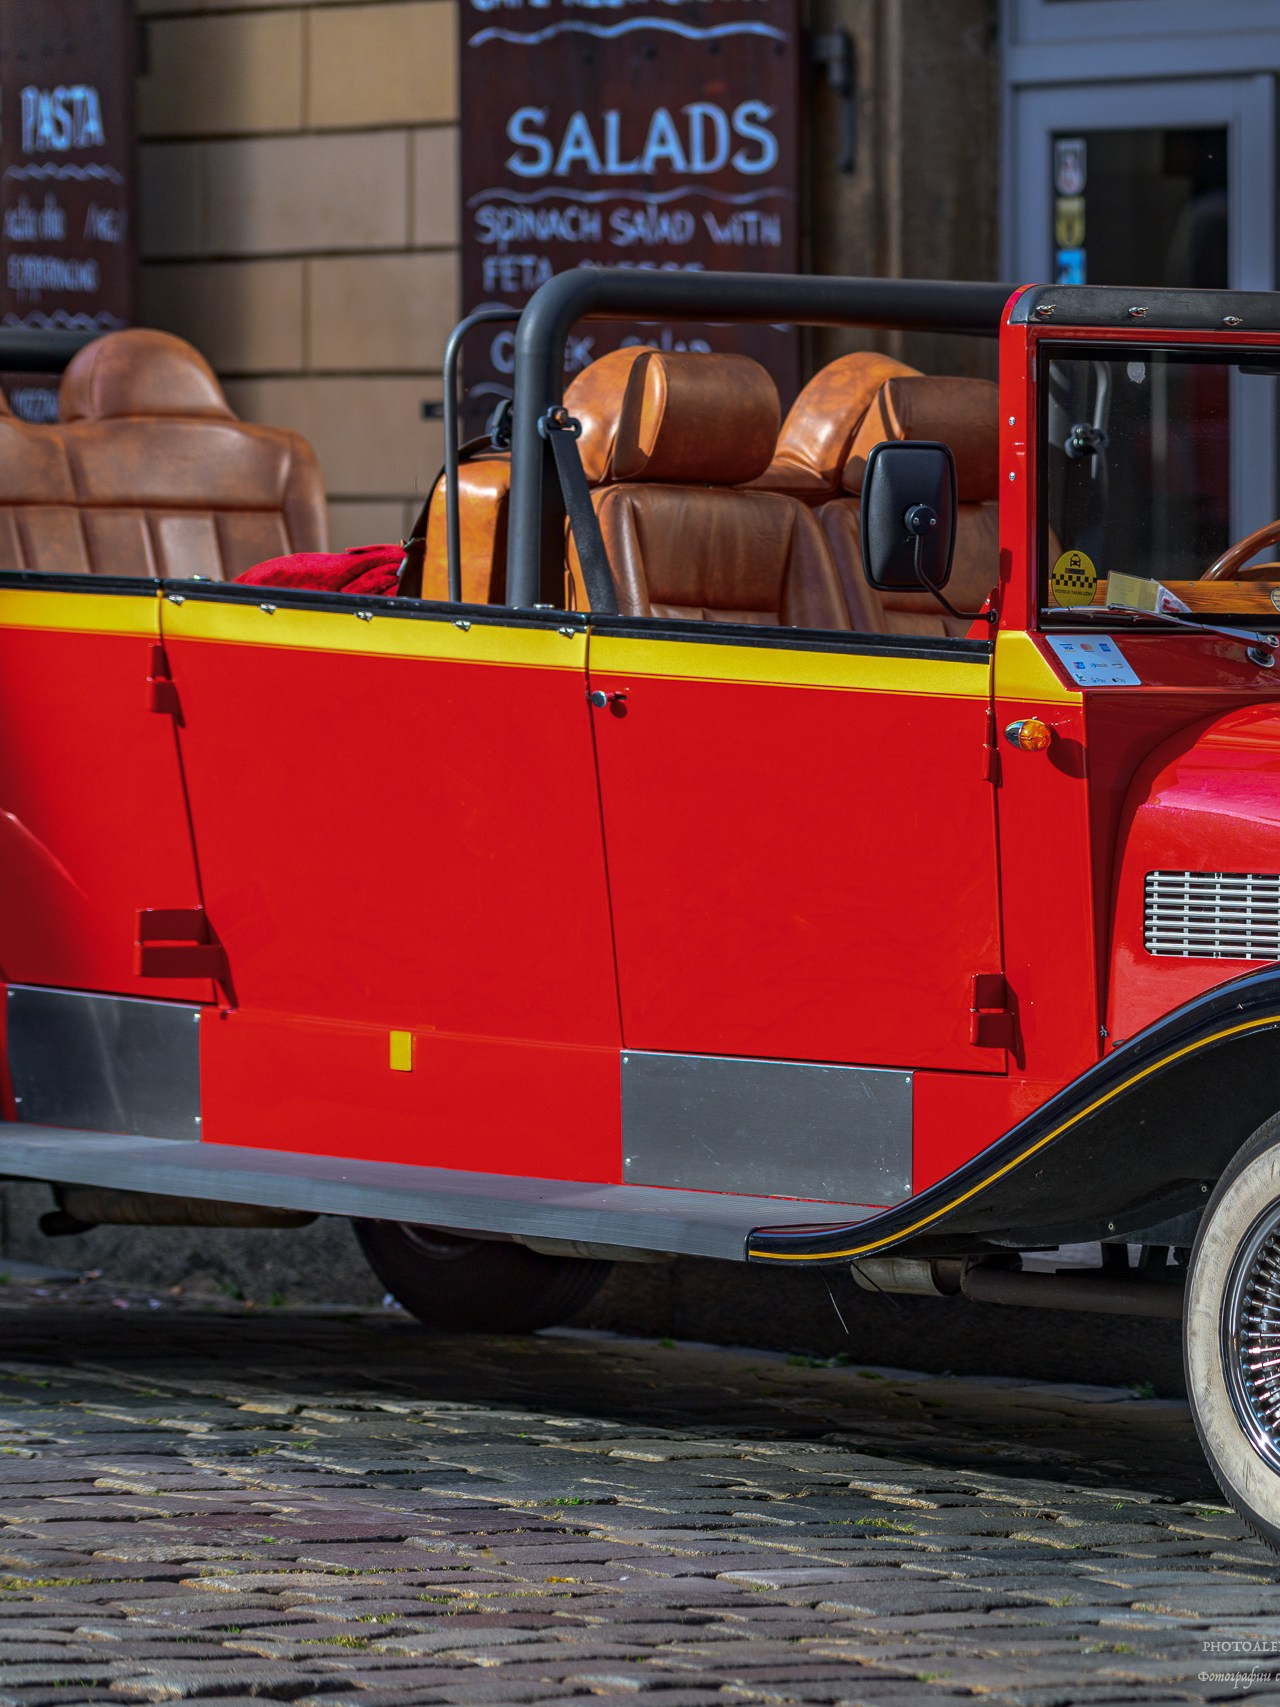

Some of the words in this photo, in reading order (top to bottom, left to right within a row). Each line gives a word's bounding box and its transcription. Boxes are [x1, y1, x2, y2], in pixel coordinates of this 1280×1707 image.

[21, 84, 105, 153] PASTA
[506, 100, 779, 177] SALADS
[474, 204, 602, 252] SPINACH
[482, 253, 554, 292] FETA
